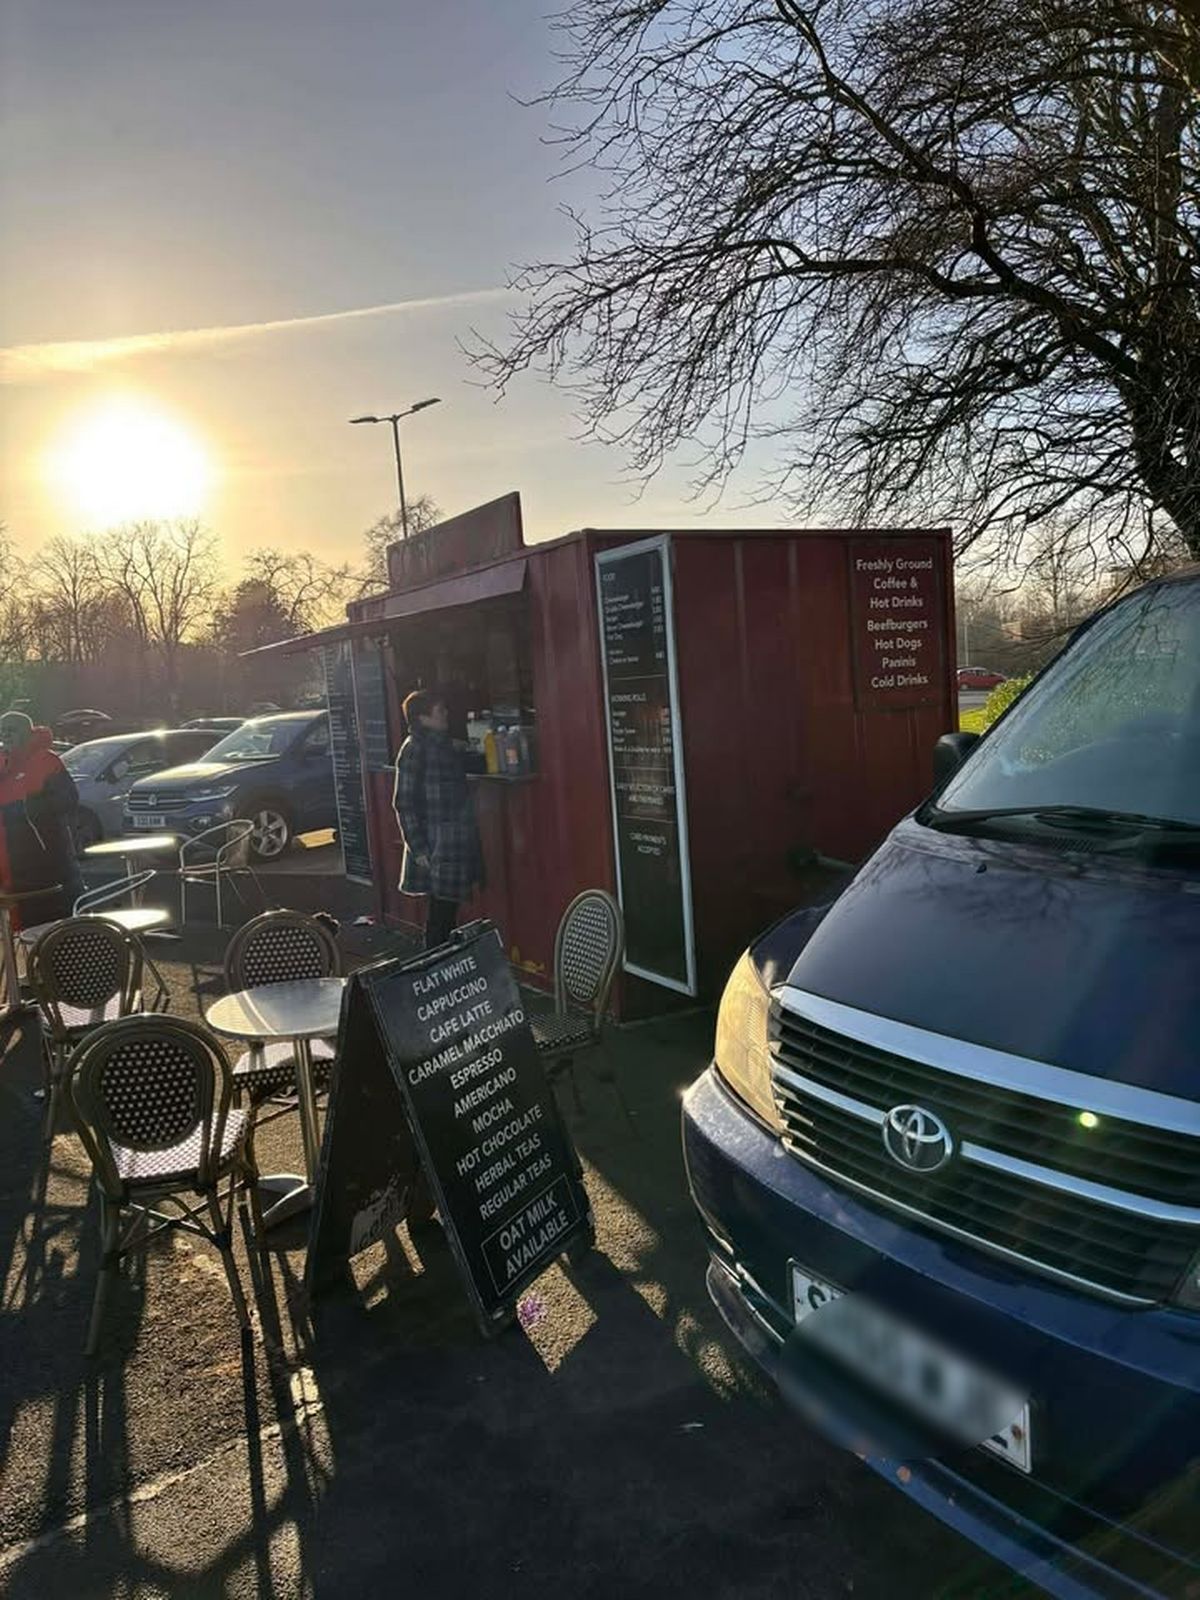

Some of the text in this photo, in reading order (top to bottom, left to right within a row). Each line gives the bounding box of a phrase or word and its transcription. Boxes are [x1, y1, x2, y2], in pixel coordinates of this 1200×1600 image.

[856, 557, 933, 573] Freshly Ground
[873, 577, 918, 589] Coffee &
[870, 596, 923, 609] Hot Drinks
[867, 619, 928, 632] Beefburgers
[875, 637, 922, 650] Hot Dogs
[871, 673, 929, 688] Cold Drinks
[882, 656, 916, 669] Paninis
[412, 956, 477, 996] FLAT WHITE
[417, 977, 488, 1021] CAPPUCCINO
[429, 1000, 493, 1043] CAFE LATTE
[408, 1009, 524, 1085] CARAMEL MACCHIATO
[450, 1048, 503, 1089] ESPRESSO
[453, 1067, 517, 1118] AMERICANO
[472, 1098, 514, 1133] MOCHA
[456, 1104, 543, 1176] HOT CHOCOLATE
[474, 1132, 541, 1194] HERBAL TEAS
[479, 1153, 552, 1220] REGULAR TEAS
[500, 1191, 558, 1250] OAT MILK
[505, 1210, 569, 1278] AVAILABLE
